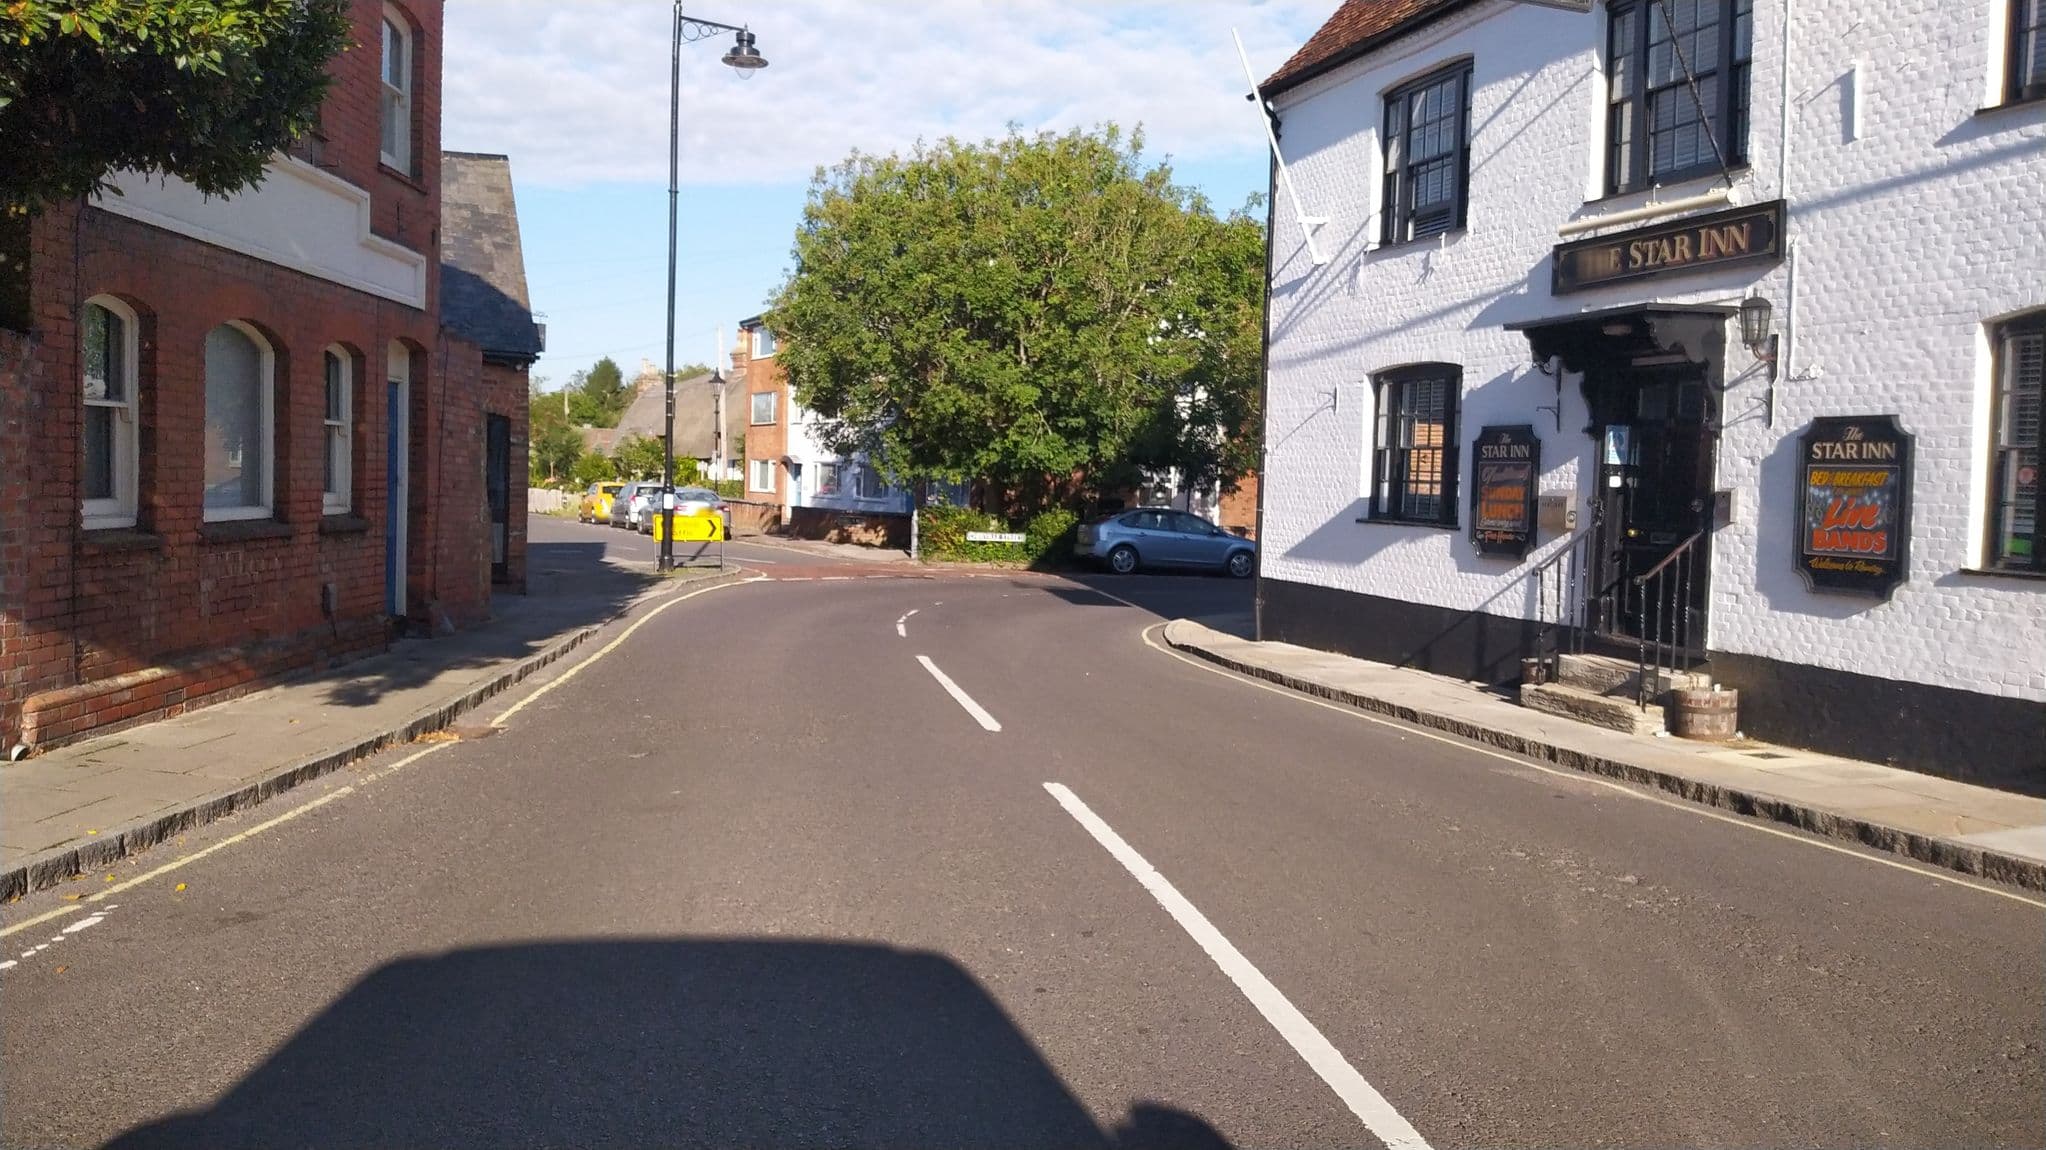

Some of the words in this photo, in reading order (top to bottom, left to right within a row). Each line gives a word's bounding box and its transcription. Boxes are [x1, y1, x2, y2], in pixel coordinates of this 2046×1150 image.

[1629, 236, 1690, 268] STAR
[1698, 223, 1752, 257] INN
[1843, 426, 1864, 441] The
[1482, 444, 1508, 458] STAR
[1510, 444, 1529, 458] INN
[1812, 442, 1858, 460] STAR
[1863, 442, 1896, 460] INN
[1824, 498, 1880, 530] Live
[1812, 530, 1888, 554] BANDS
